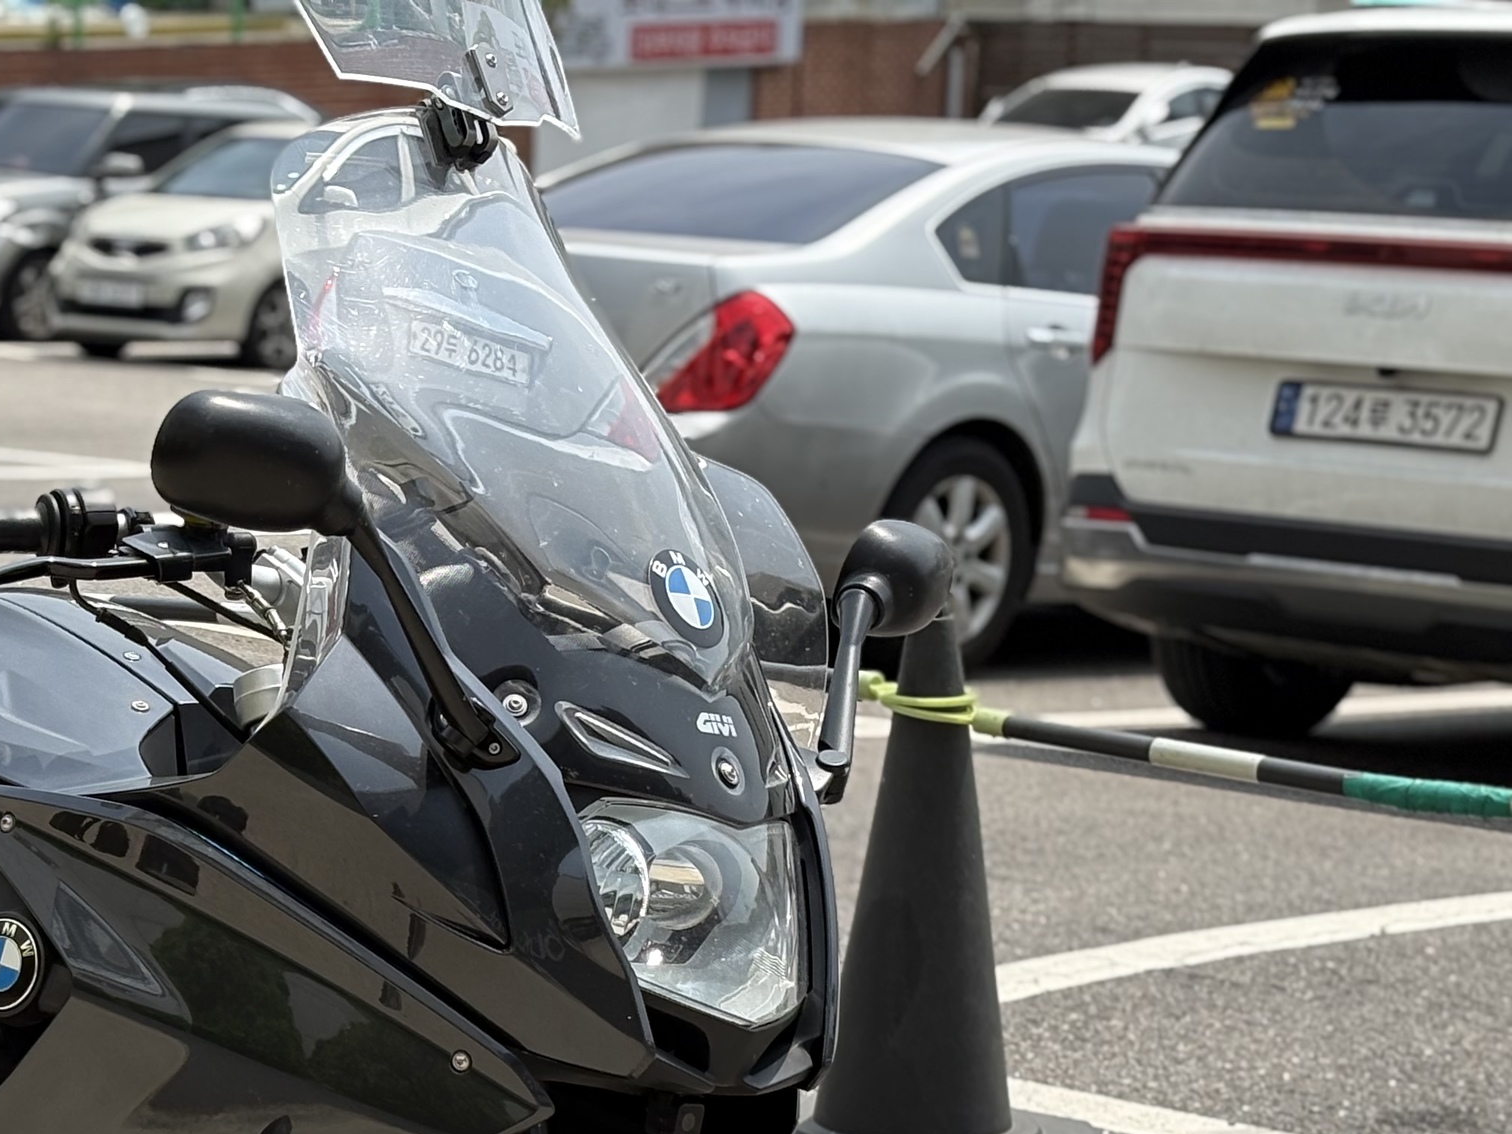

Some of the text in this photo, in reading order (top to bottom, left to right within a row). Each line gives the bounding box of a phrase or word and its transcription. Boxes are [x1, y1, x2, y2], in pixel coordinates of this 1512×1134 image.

[467, 339, 518, 378] 6284
[1396, 396, 1488, 442] 3572
[651, 550, 713, 587] BMW
[696, 712, 738, 738] GIVI
